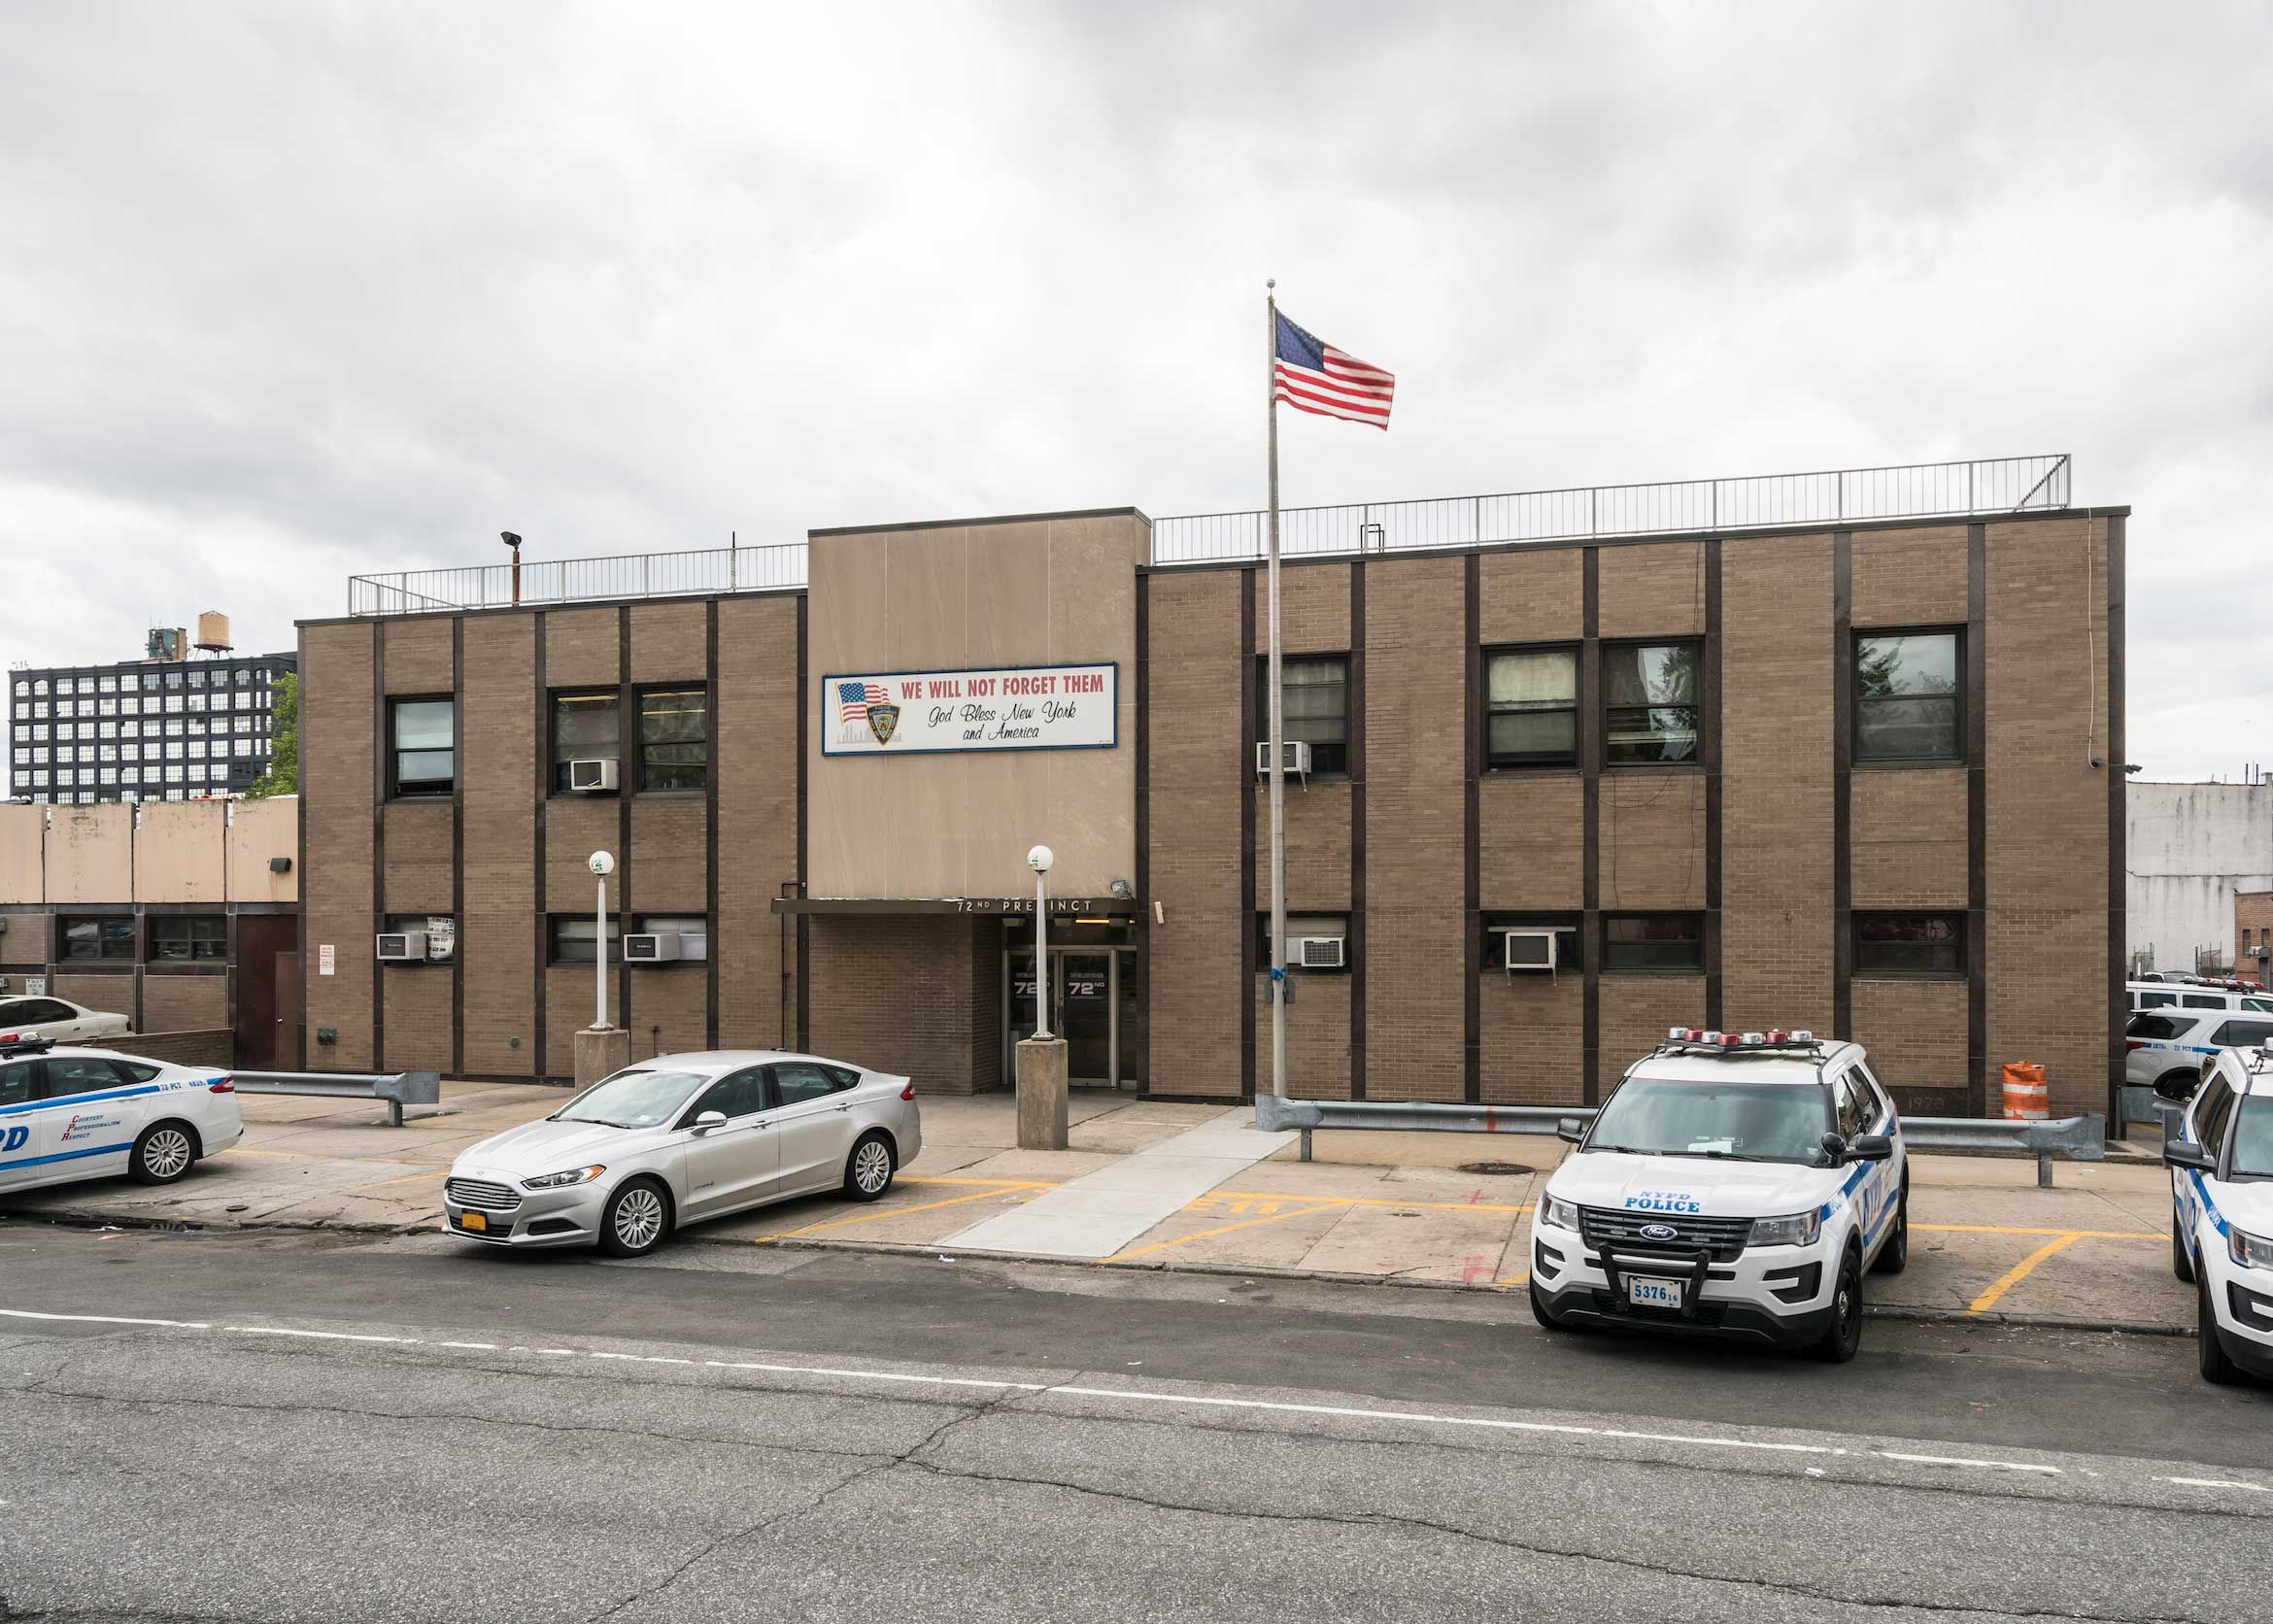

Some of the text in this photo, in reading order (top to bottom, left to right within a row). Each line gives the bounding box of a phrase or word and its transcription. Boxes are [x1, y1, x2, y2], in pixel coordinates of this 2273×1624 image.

[901, 674, 1103, 699] WE WILL NOT FORGET THEM
[928, 700, 1076, 727] God Bless New York
[963, 722, 1039, 740] and America
[1002, 899, 1092, 912] PREINCT
[1640, 1191, 1692, 1201] NYPD
[1625, 1197, 1700, 1213] POLICE
[1646, 1226, 1669, 1237] Ford
[1635, 1284, 1667, 1300] 5376
